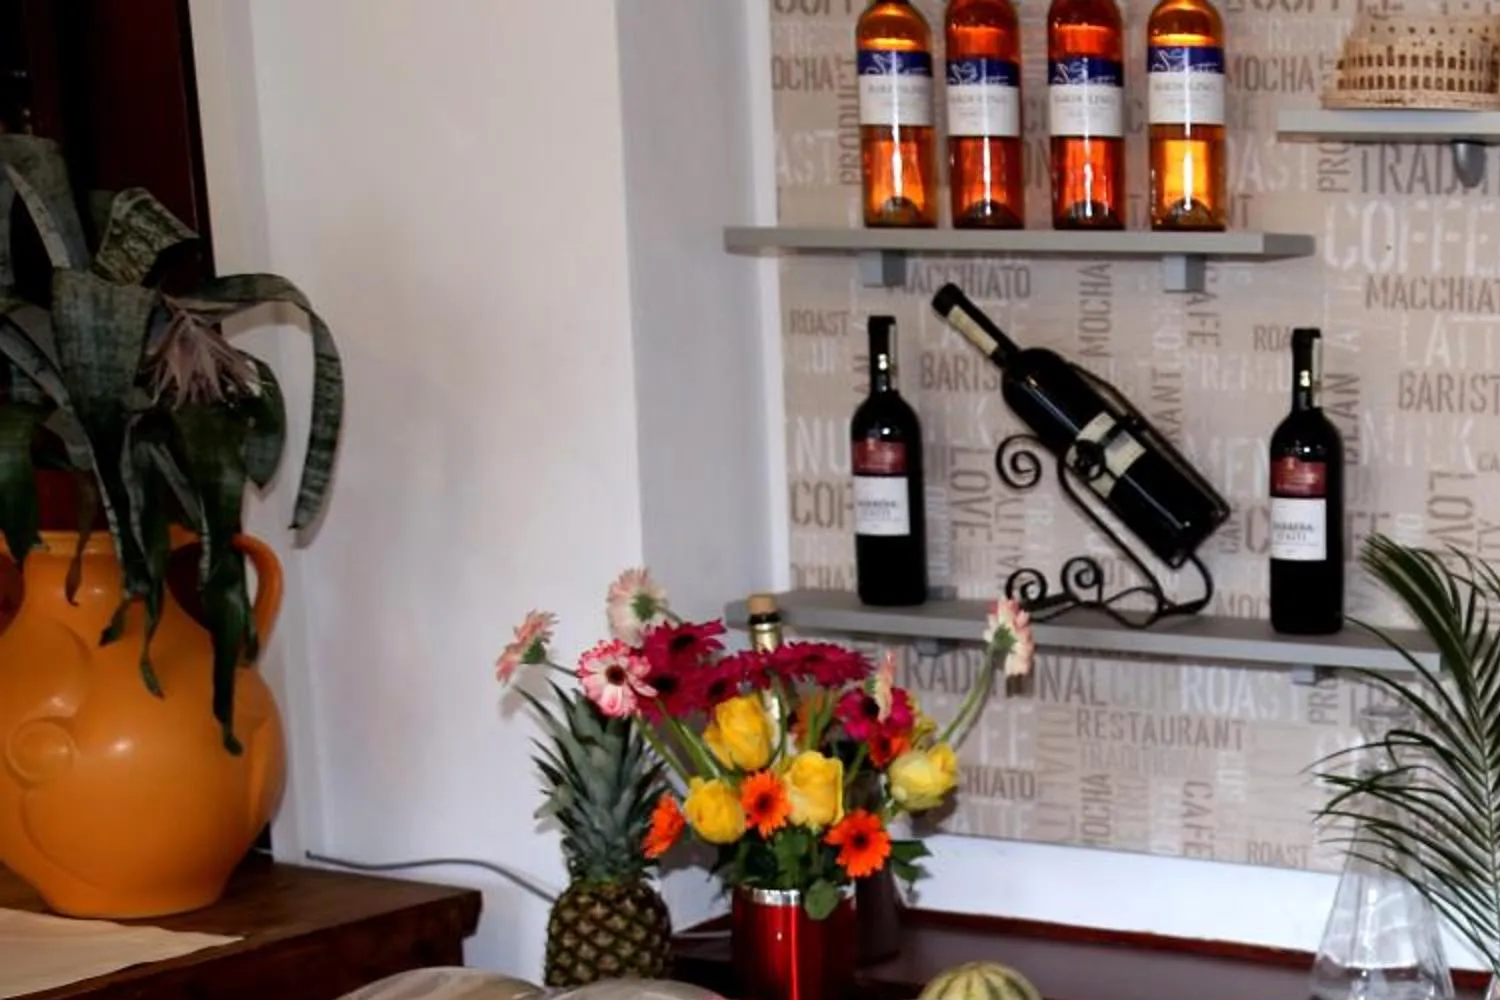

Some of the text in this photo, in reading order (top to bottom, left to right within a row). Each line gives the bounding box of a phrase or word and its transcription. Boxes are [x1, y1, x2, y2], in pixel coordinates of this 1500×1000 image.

[770, 56, 836, 92] OCHA
[1228, 54, 1315, 93] MOCHA
[886, 260, 1032, 301] ACCHIATO
[789, 309, 849, 337] ROAST
[1078, 260, 1113, 358] MOCHA
[1253, 324, 1292, 351] ROA
[919, 353, 999, 393] BARIS
[1425, 470, 1477, 552] LOV
[1075, 707, 1247, 751] RESTAURANT
[962, 765, 1036, 801] HIATO
[1079, 773, 1113, 845] OCHA
[1246, 838, 1311, 869] ROAST
